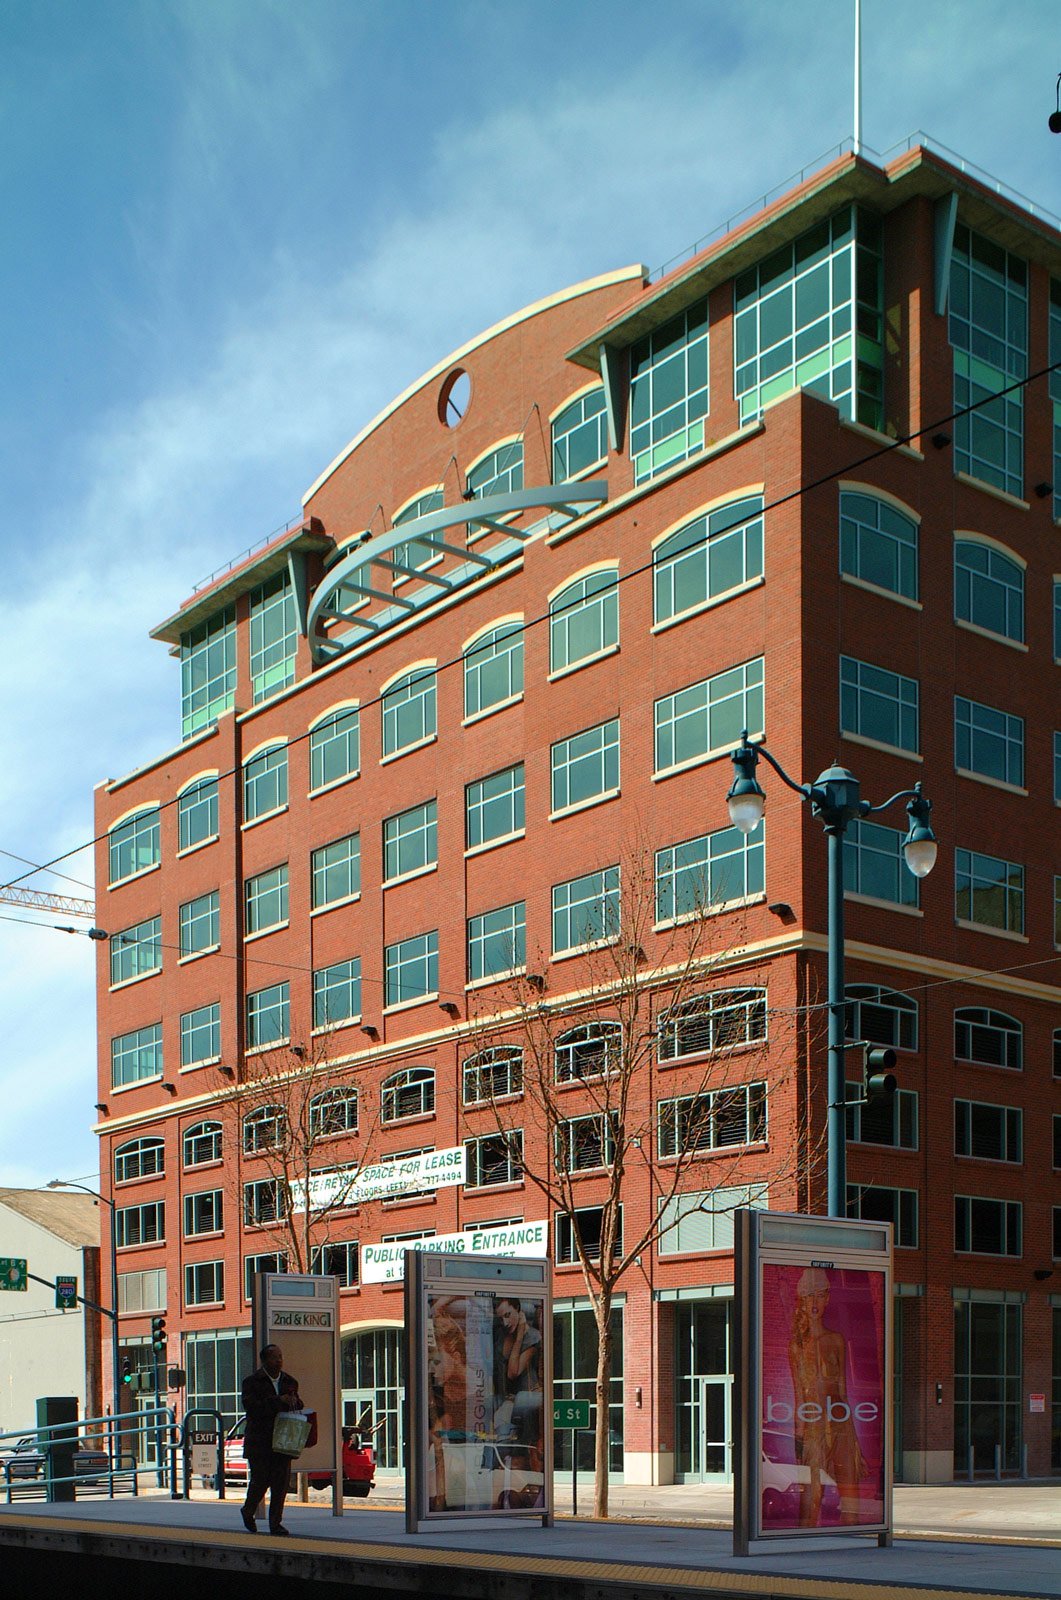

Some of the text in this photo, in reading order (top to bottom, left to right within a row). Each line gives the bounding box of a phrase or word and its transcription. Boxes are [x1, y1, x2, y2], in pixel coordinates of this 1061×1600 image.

[363, 1167, 395, 1182] SPACE
[400, 1160, 421, 1175] FOR
[425, 1151, 462, 1170] LEASE
[472, 1227, 543, 1251] ENTRANCE
[386, 1267, 394, 1278] at
[274, 1313, 327, 1326] 2nd & KING
[566, 1408, 580, 1420] St
[767, 1395, 878, 1422] bebe
[195, 1433, 214, 1442] EXIT
